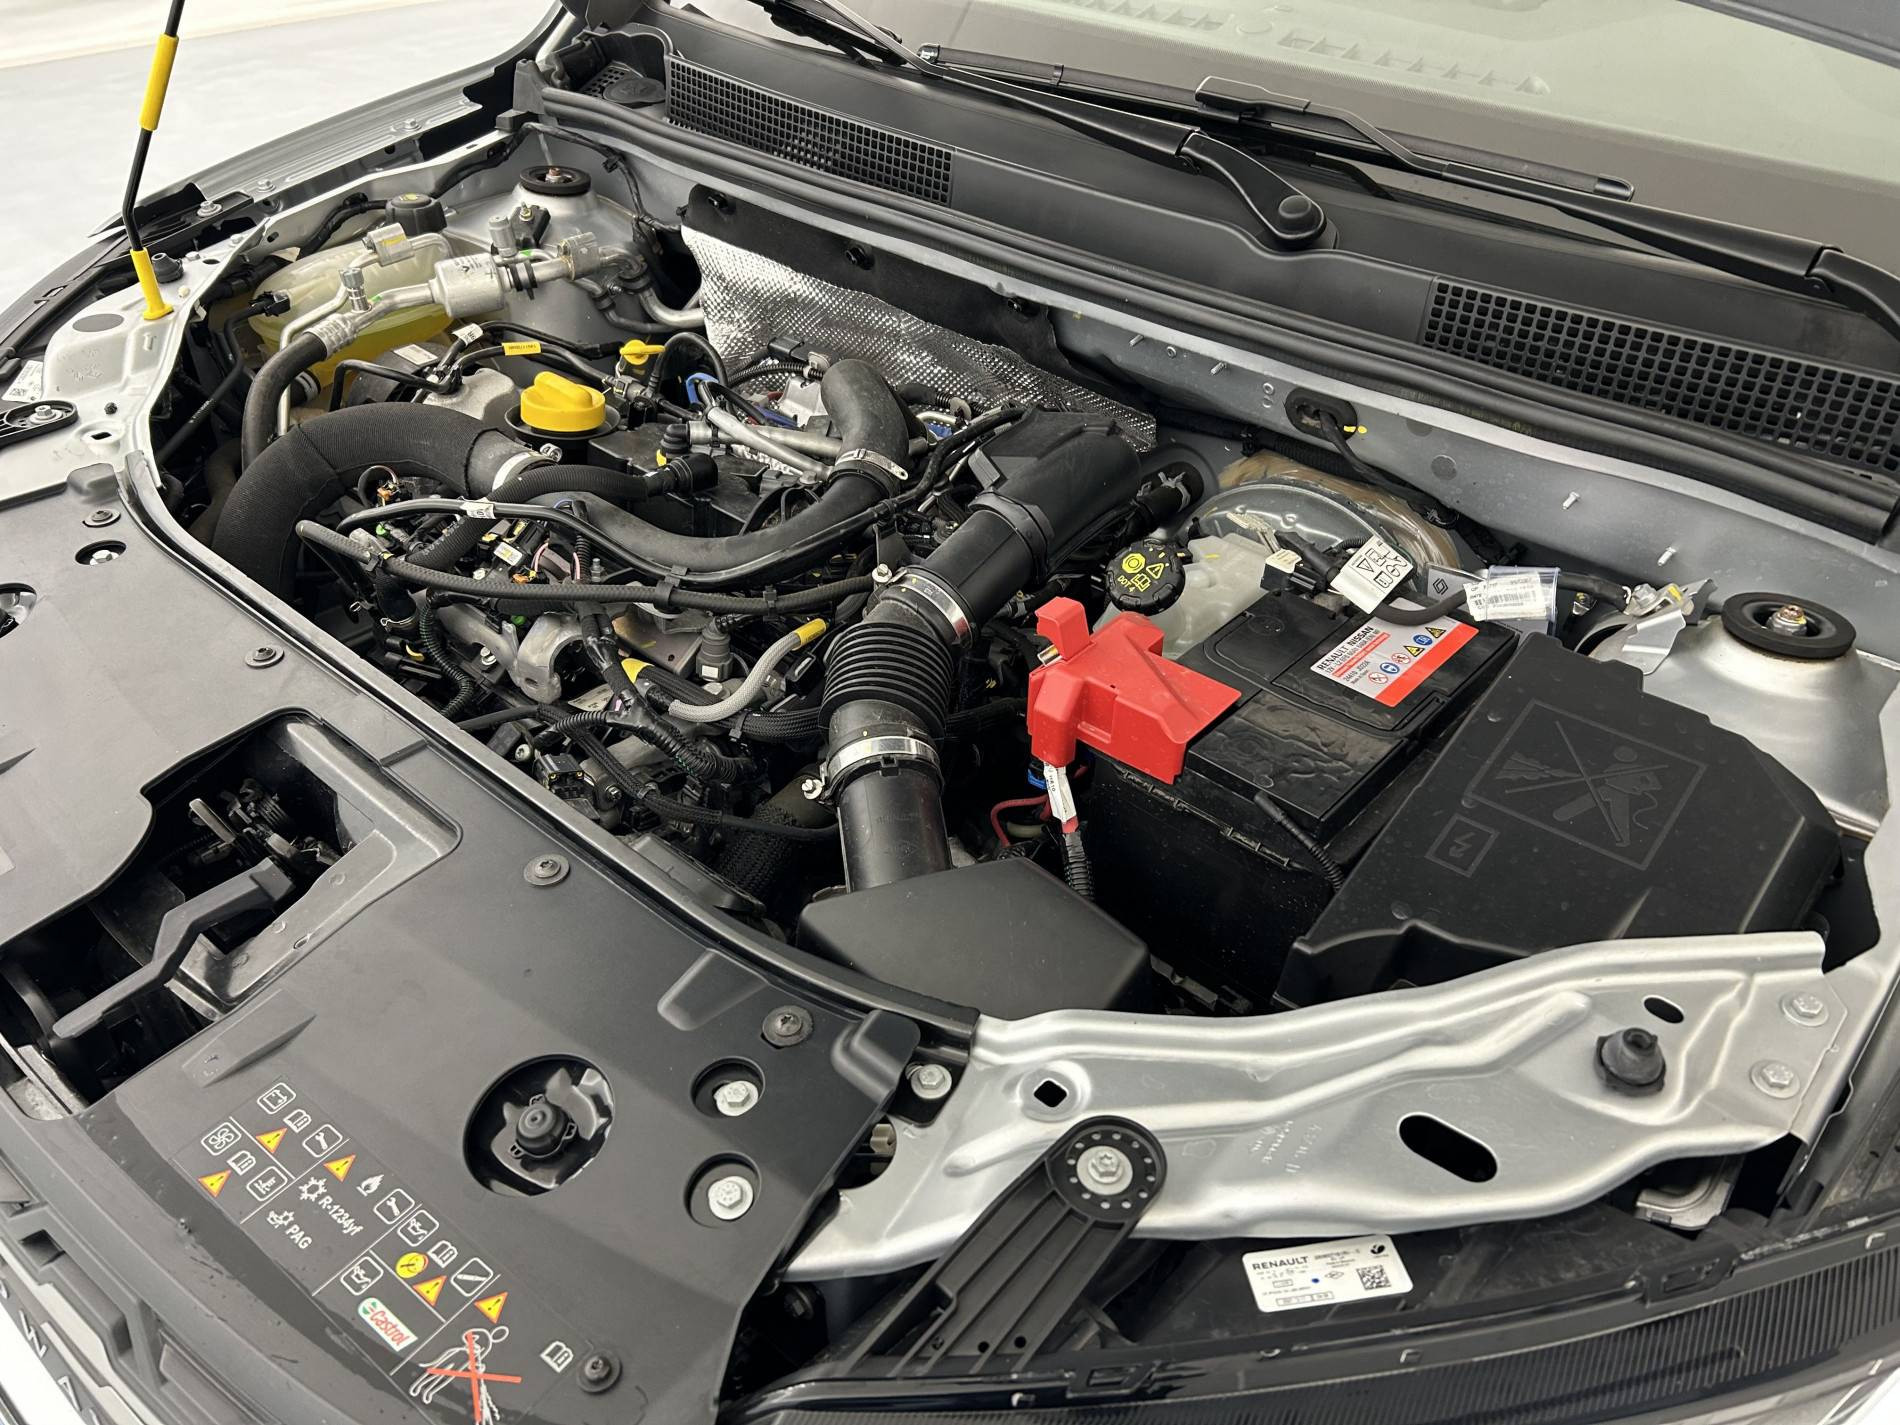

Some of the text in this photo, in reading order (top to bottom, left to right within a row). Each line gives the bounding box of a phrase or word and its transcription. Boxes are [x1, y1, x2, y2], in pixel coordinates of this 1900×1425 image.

[1117, 575, 1131, 588] DOT
[1317, 646, 1350, 671] RENAULT
[1347, 626, 1374, 647] NISSAN
[318, 1196, 364, 1236] R-1234yf
[285, 1224, 312, 1249] PAG
[1252, 1255, 1309, 1270] RENAULT
[370, 1310, 411, 1346] Castrol
